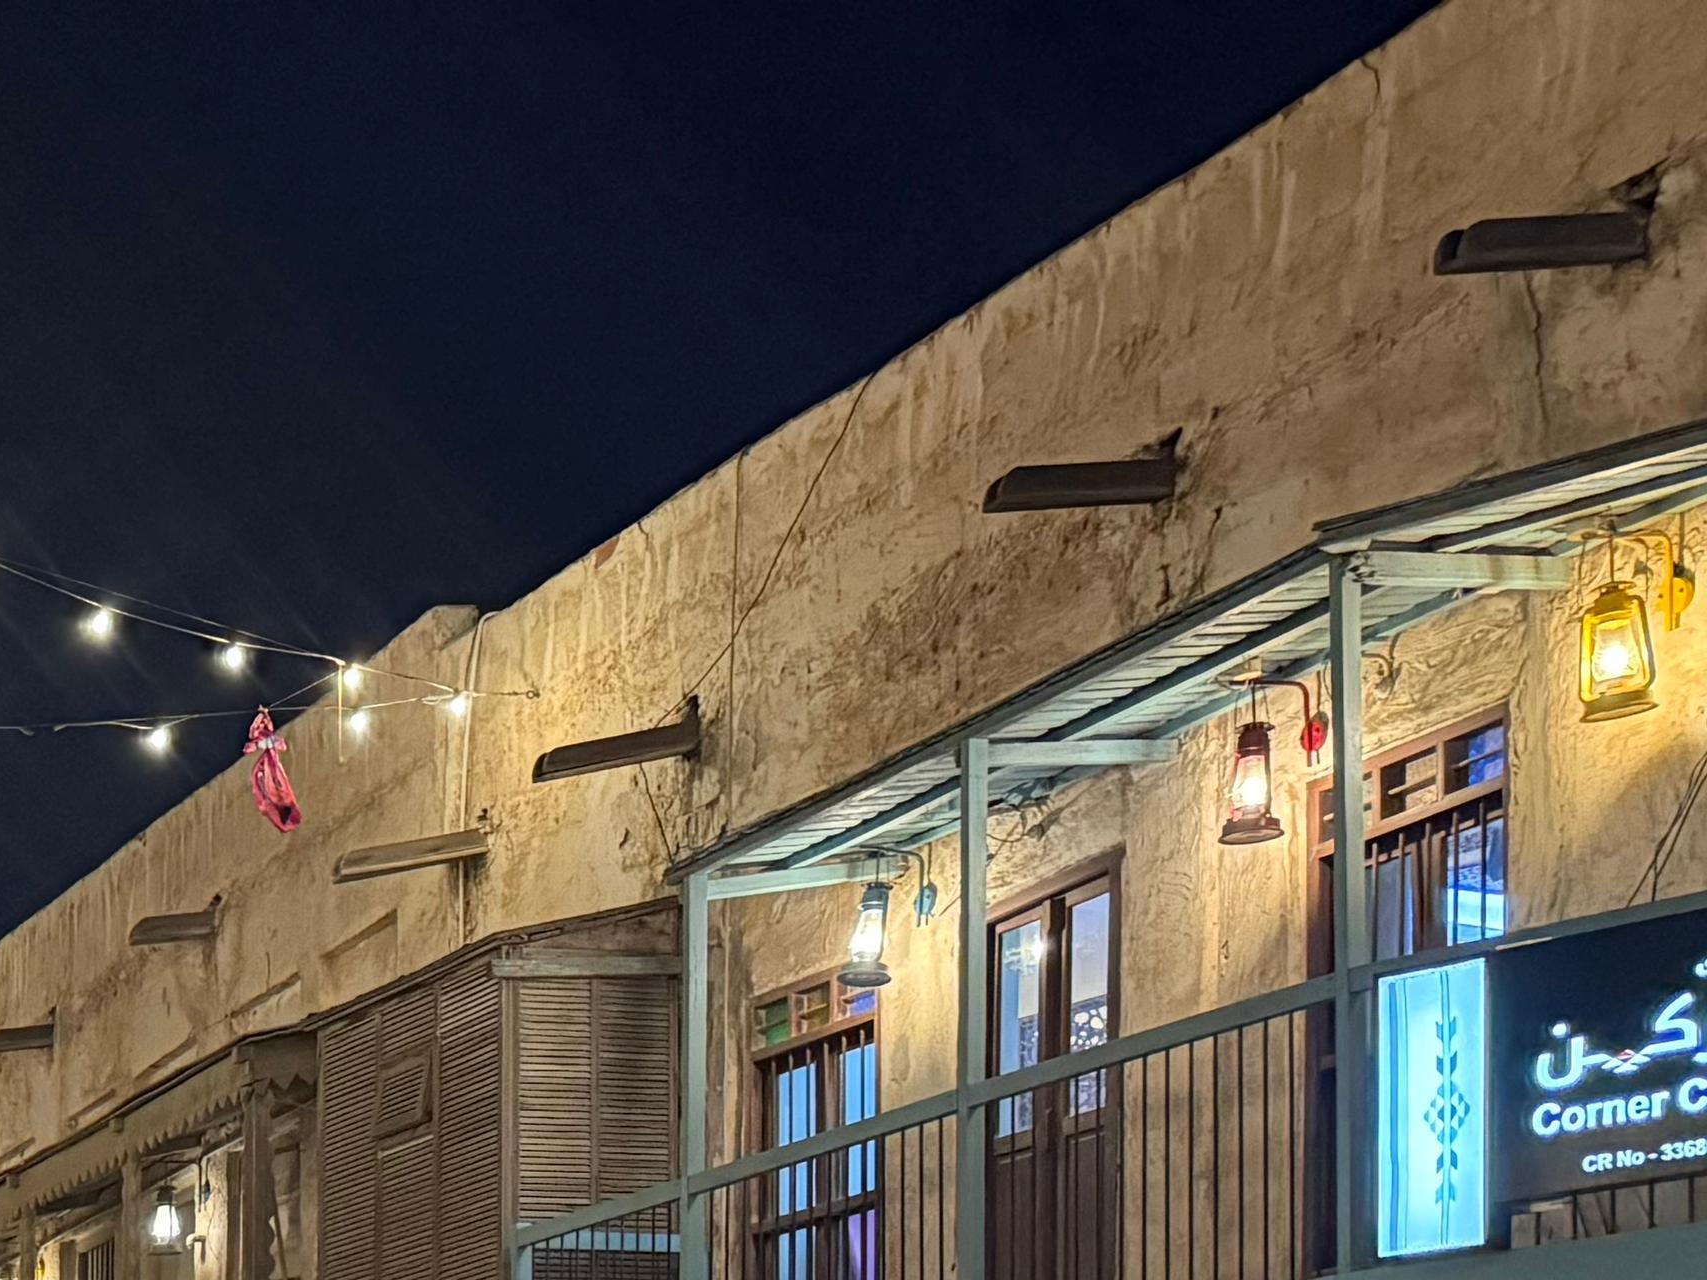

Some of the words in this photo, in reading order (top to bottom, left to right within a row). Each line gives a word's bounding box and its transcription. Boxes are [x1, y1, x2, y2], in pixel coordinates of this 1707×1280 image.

[1532, 1090, 1670, 1136] Corner
[1581, 1153, 1613, 1172] CR
[1616, 1150, 1645, 1168] No
